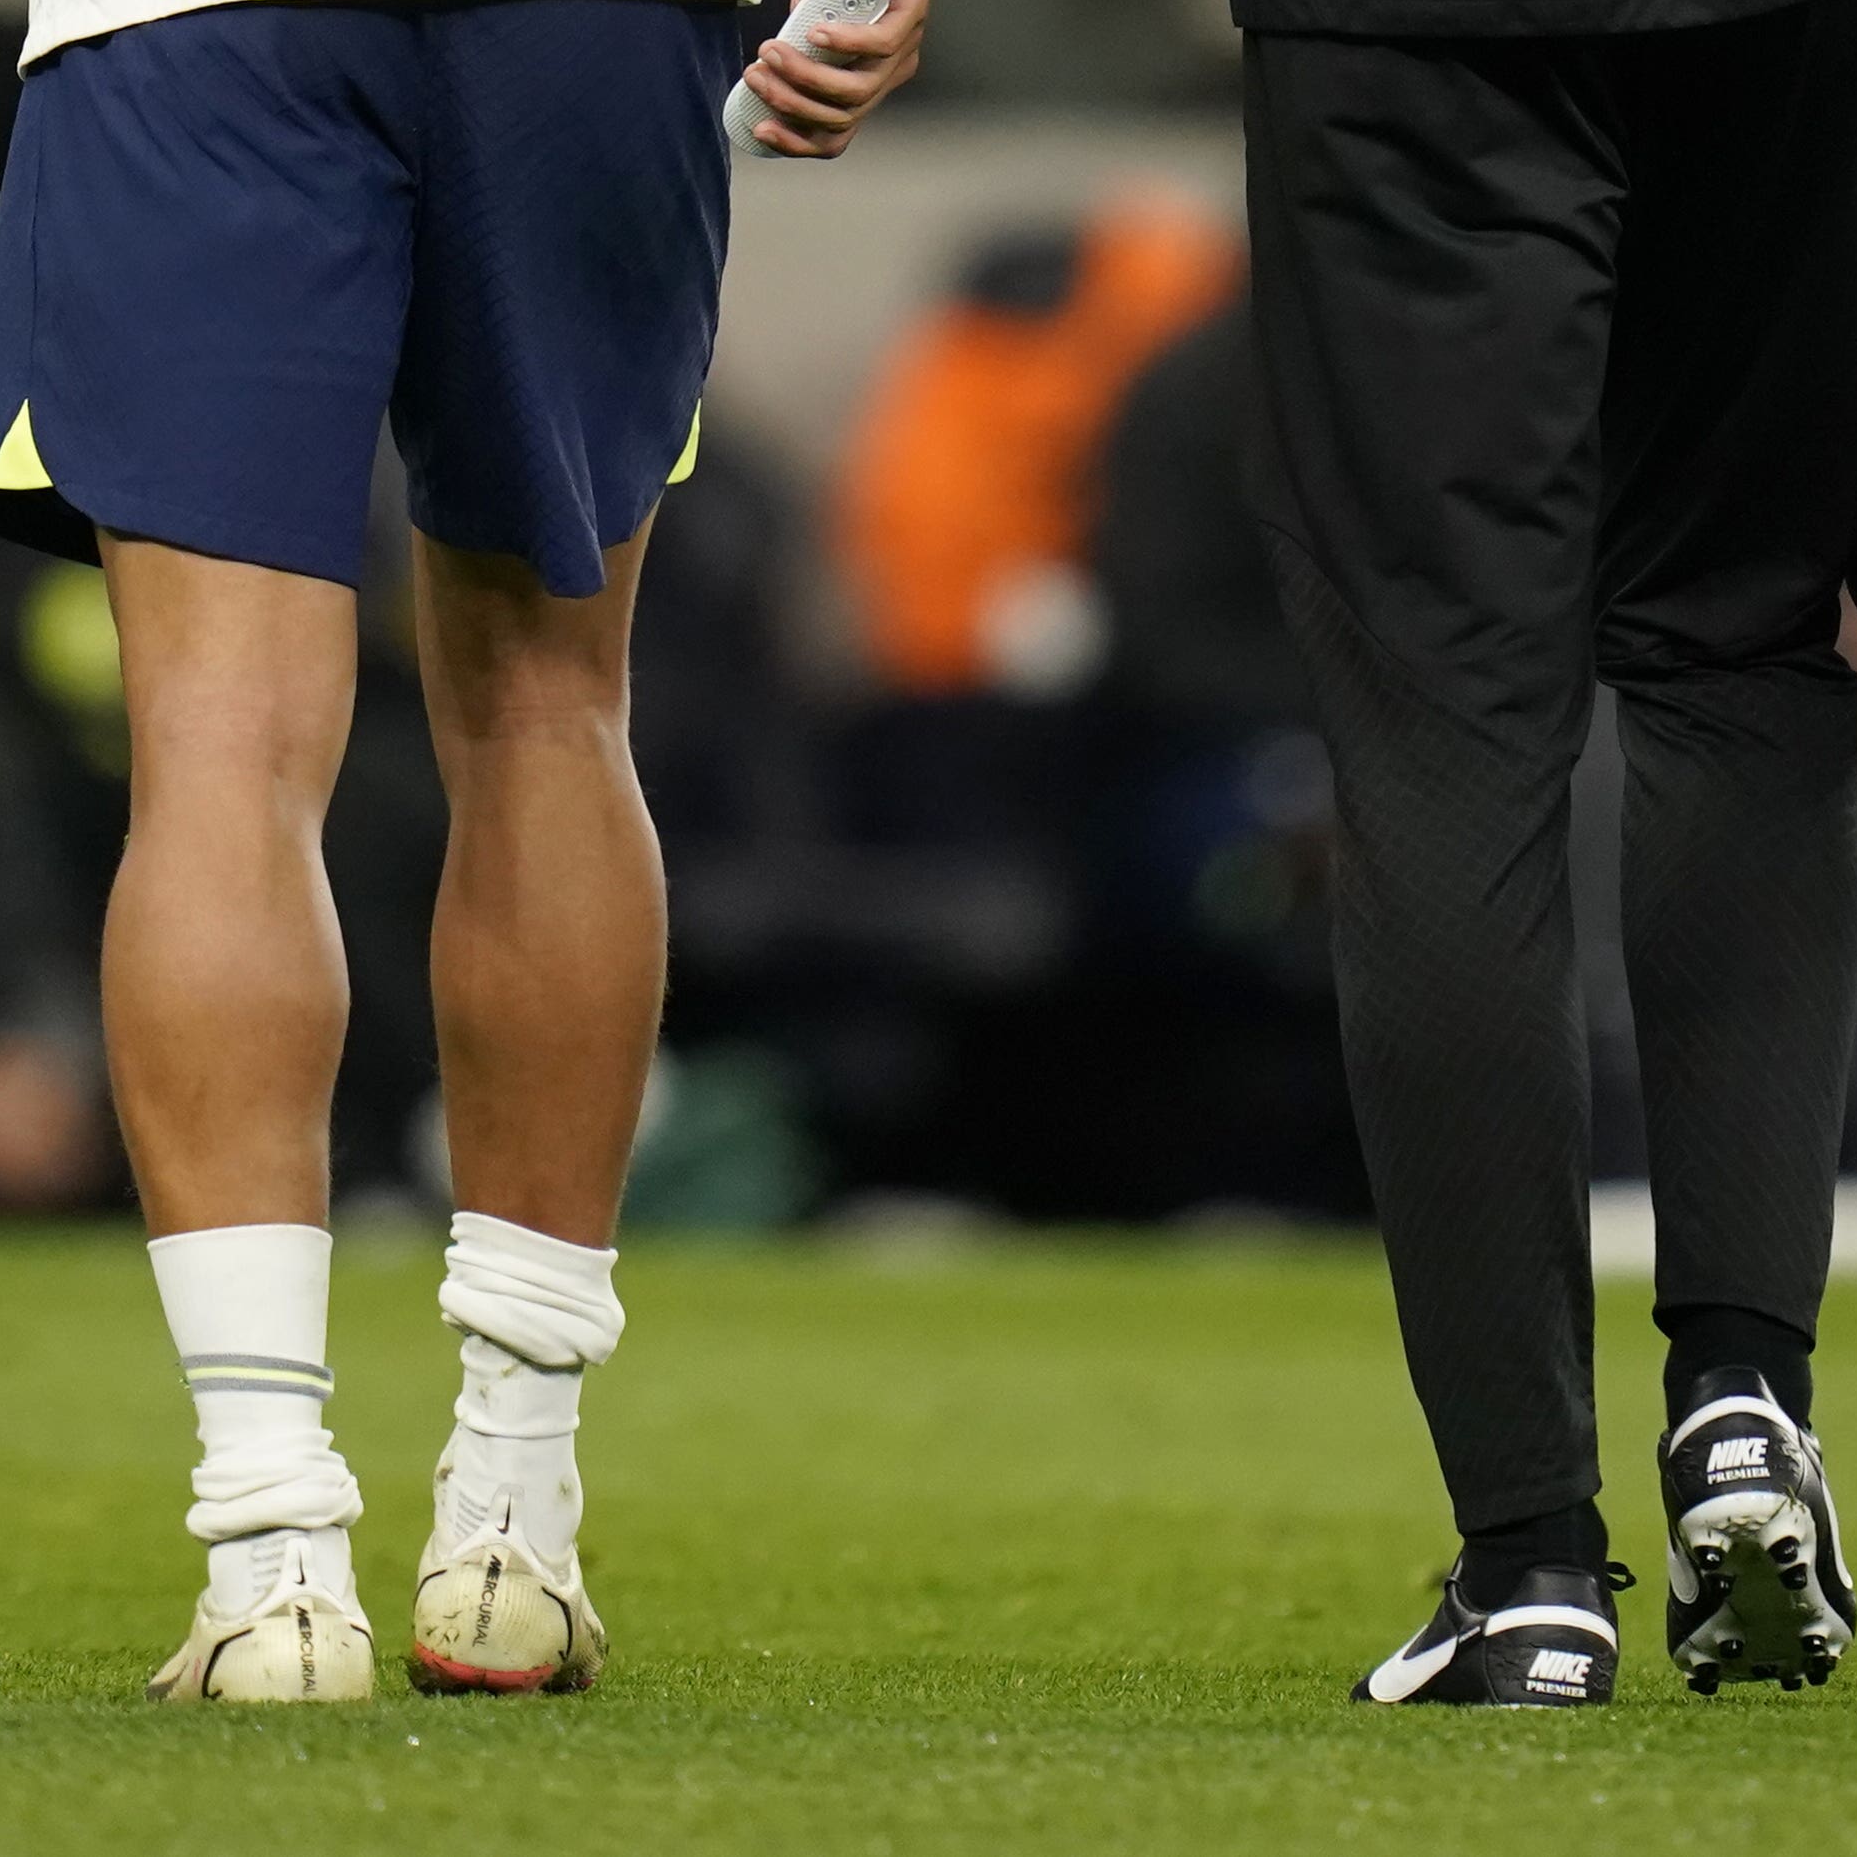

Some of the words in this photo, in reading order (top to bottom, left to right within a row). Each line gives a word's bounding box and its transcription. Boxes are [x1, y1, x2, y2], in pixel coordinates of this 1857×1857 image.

[1706, 1437, 1769, 1473] NIKE
[1707, 1467, 1771, 1485] PREMIER
[472, 1554, 503, 1647] MERCURIAL
[295, 1604, 317, 1697] MERCURIAL
[1527, 1649, 1593, 1685] NIKE
[1526, 1679, 1587, 1698] PREMIER
